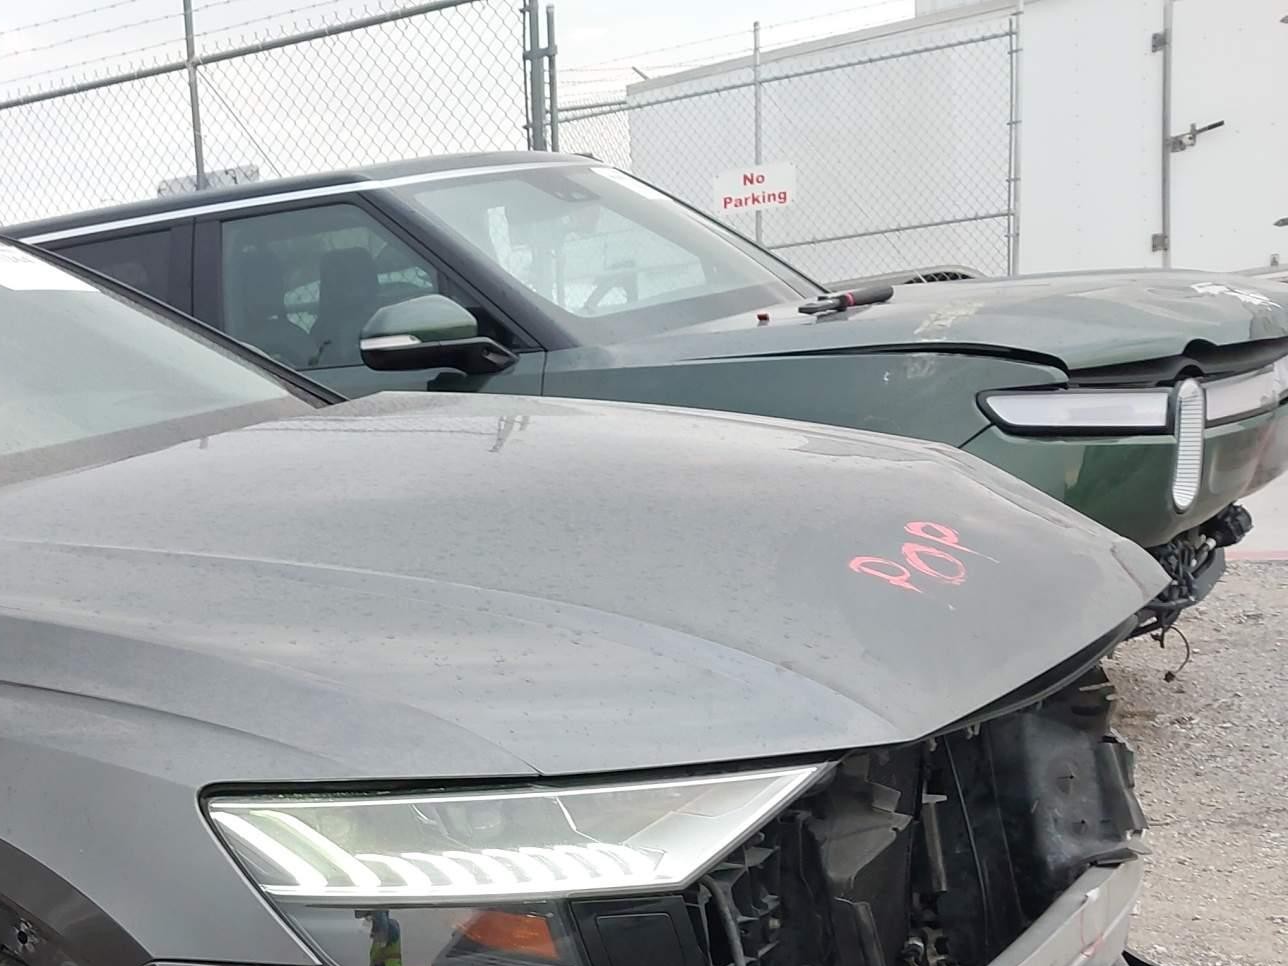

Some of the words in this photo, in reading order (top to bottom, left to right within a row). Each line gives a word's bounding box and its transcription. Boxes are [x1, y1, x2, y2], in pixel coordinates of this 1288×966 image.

[743, 173, 765, 186] No
[723, 191, 787, 209] Parking
[849, 521, 1000, 593] POP
